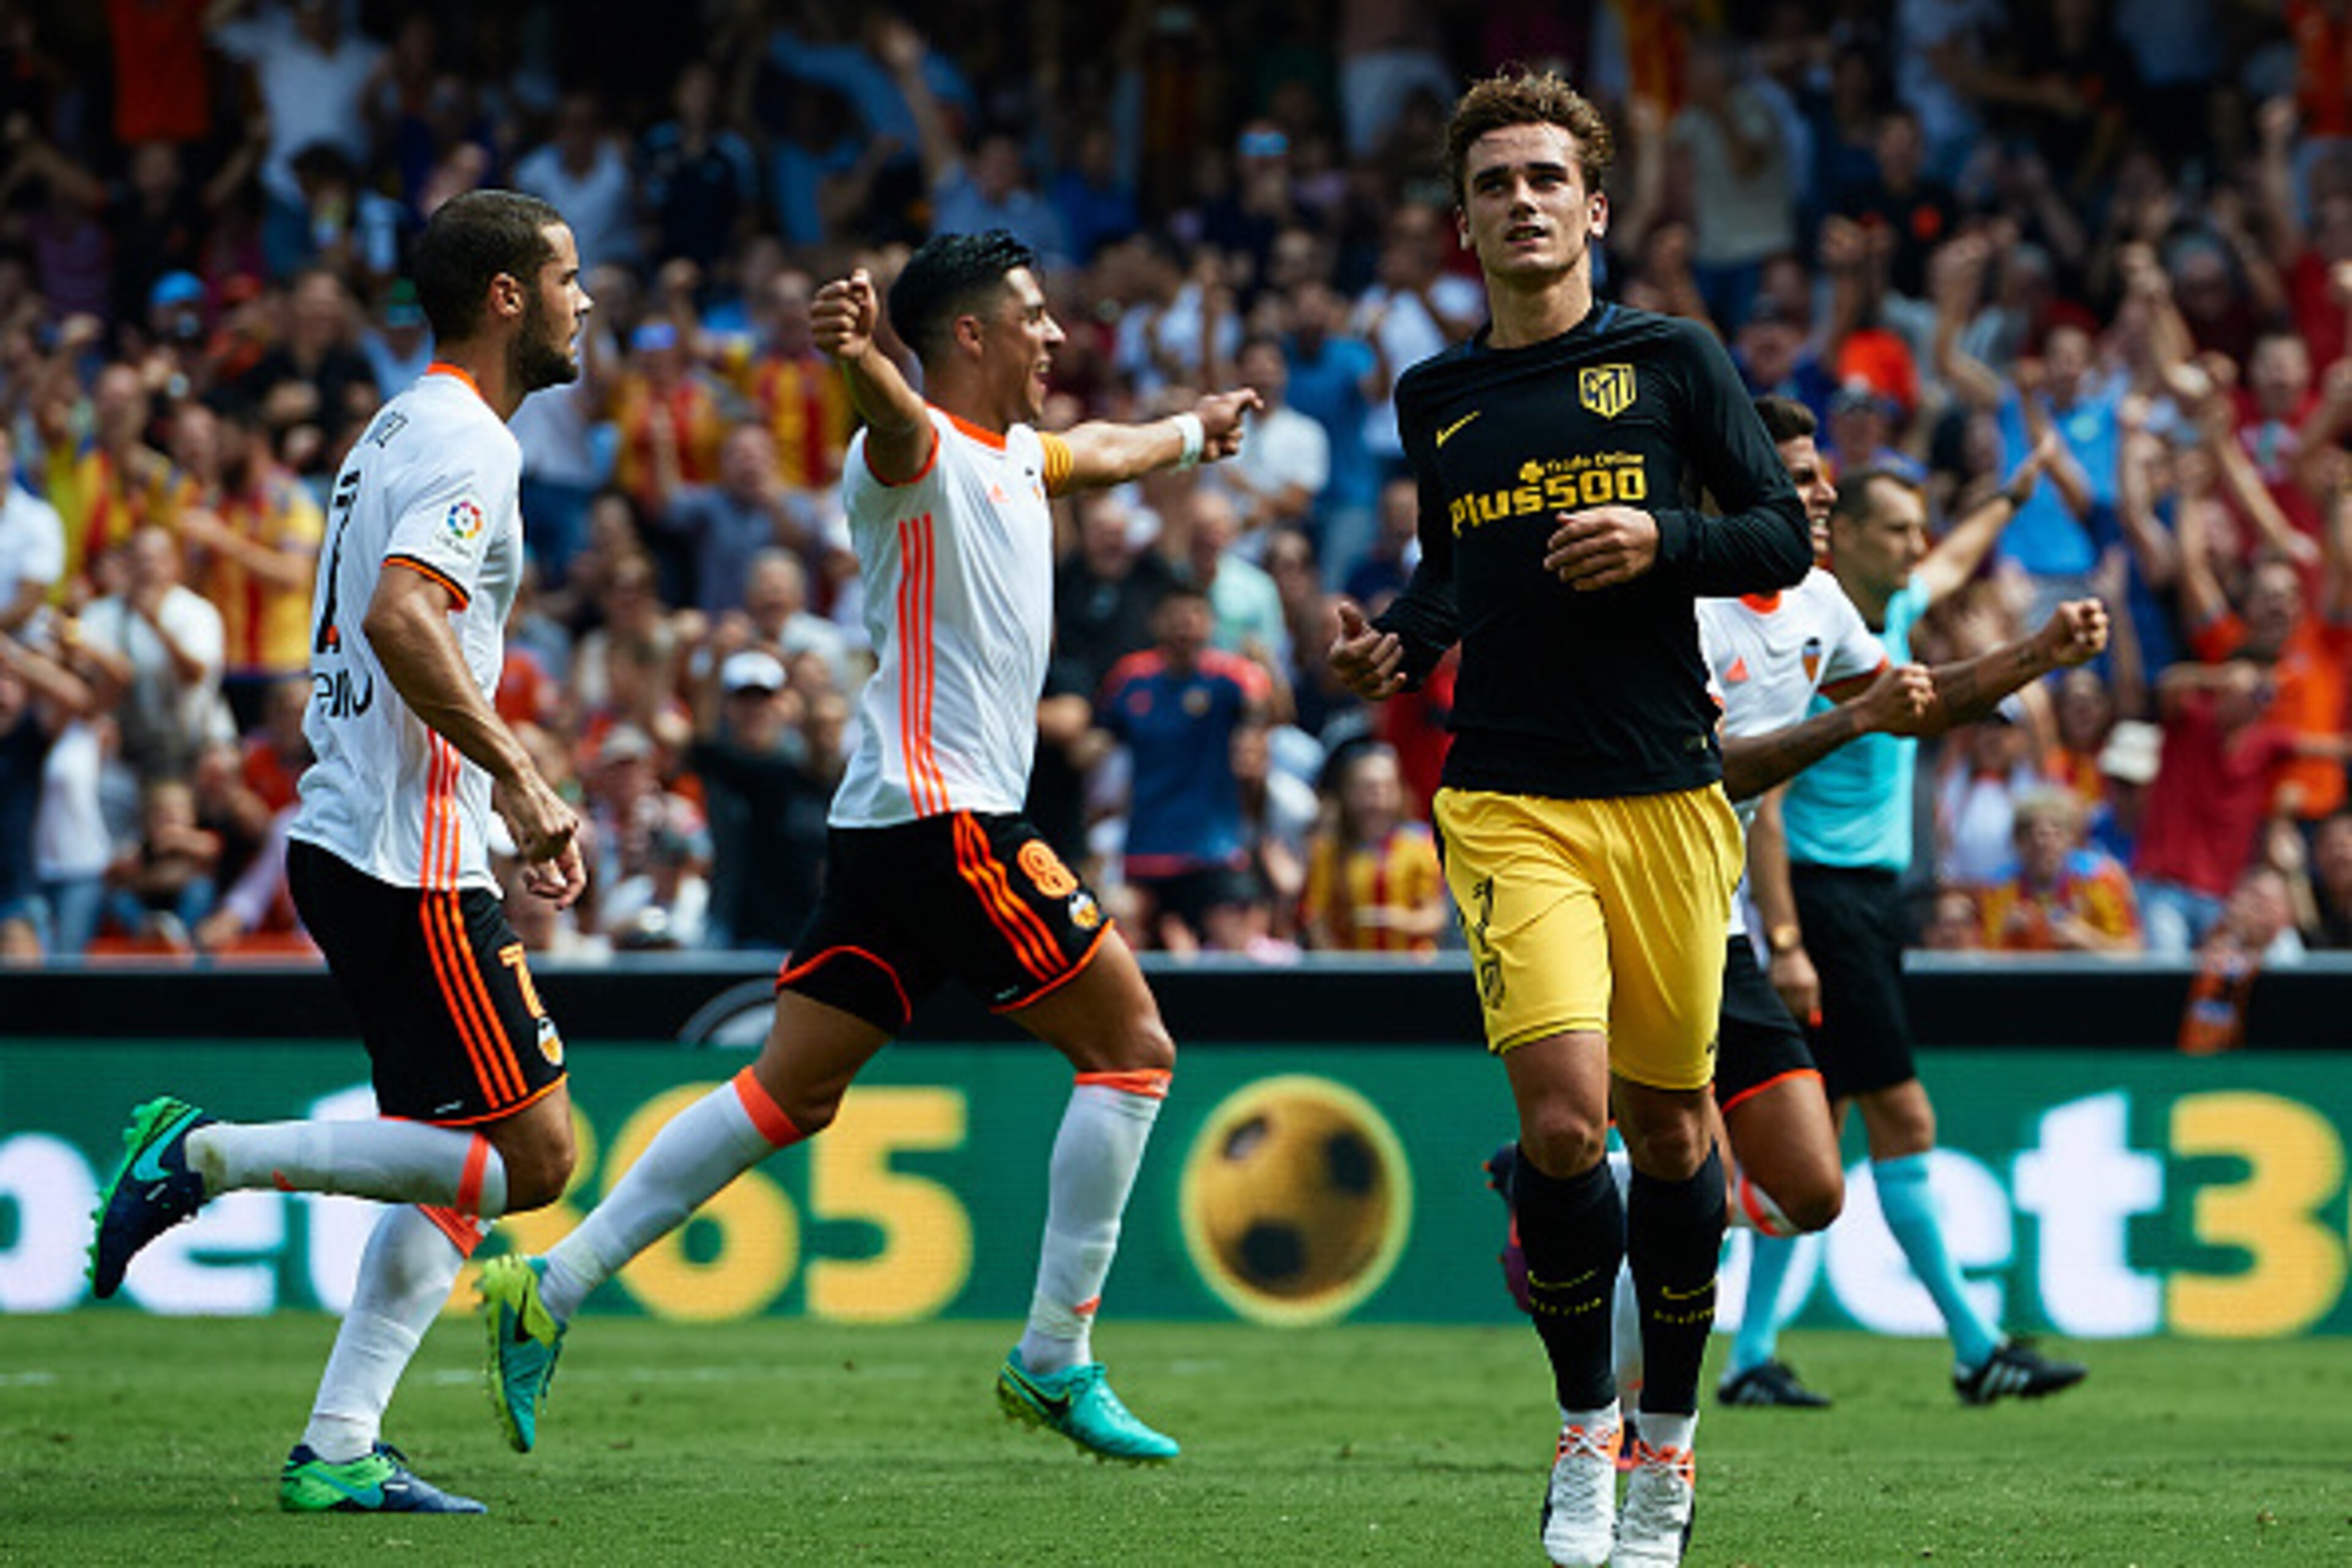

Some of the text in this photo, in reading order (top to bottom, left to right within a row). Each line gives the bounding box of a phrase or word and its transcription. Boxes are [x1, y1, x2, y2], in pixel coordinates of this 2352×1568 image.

[1449, 467, 1647, 538] Plus500
[1017, 839, 1078, 899] 8
[498, 941, 546, 1019] 7
[1715, 1089, 2347, 1339] et3
